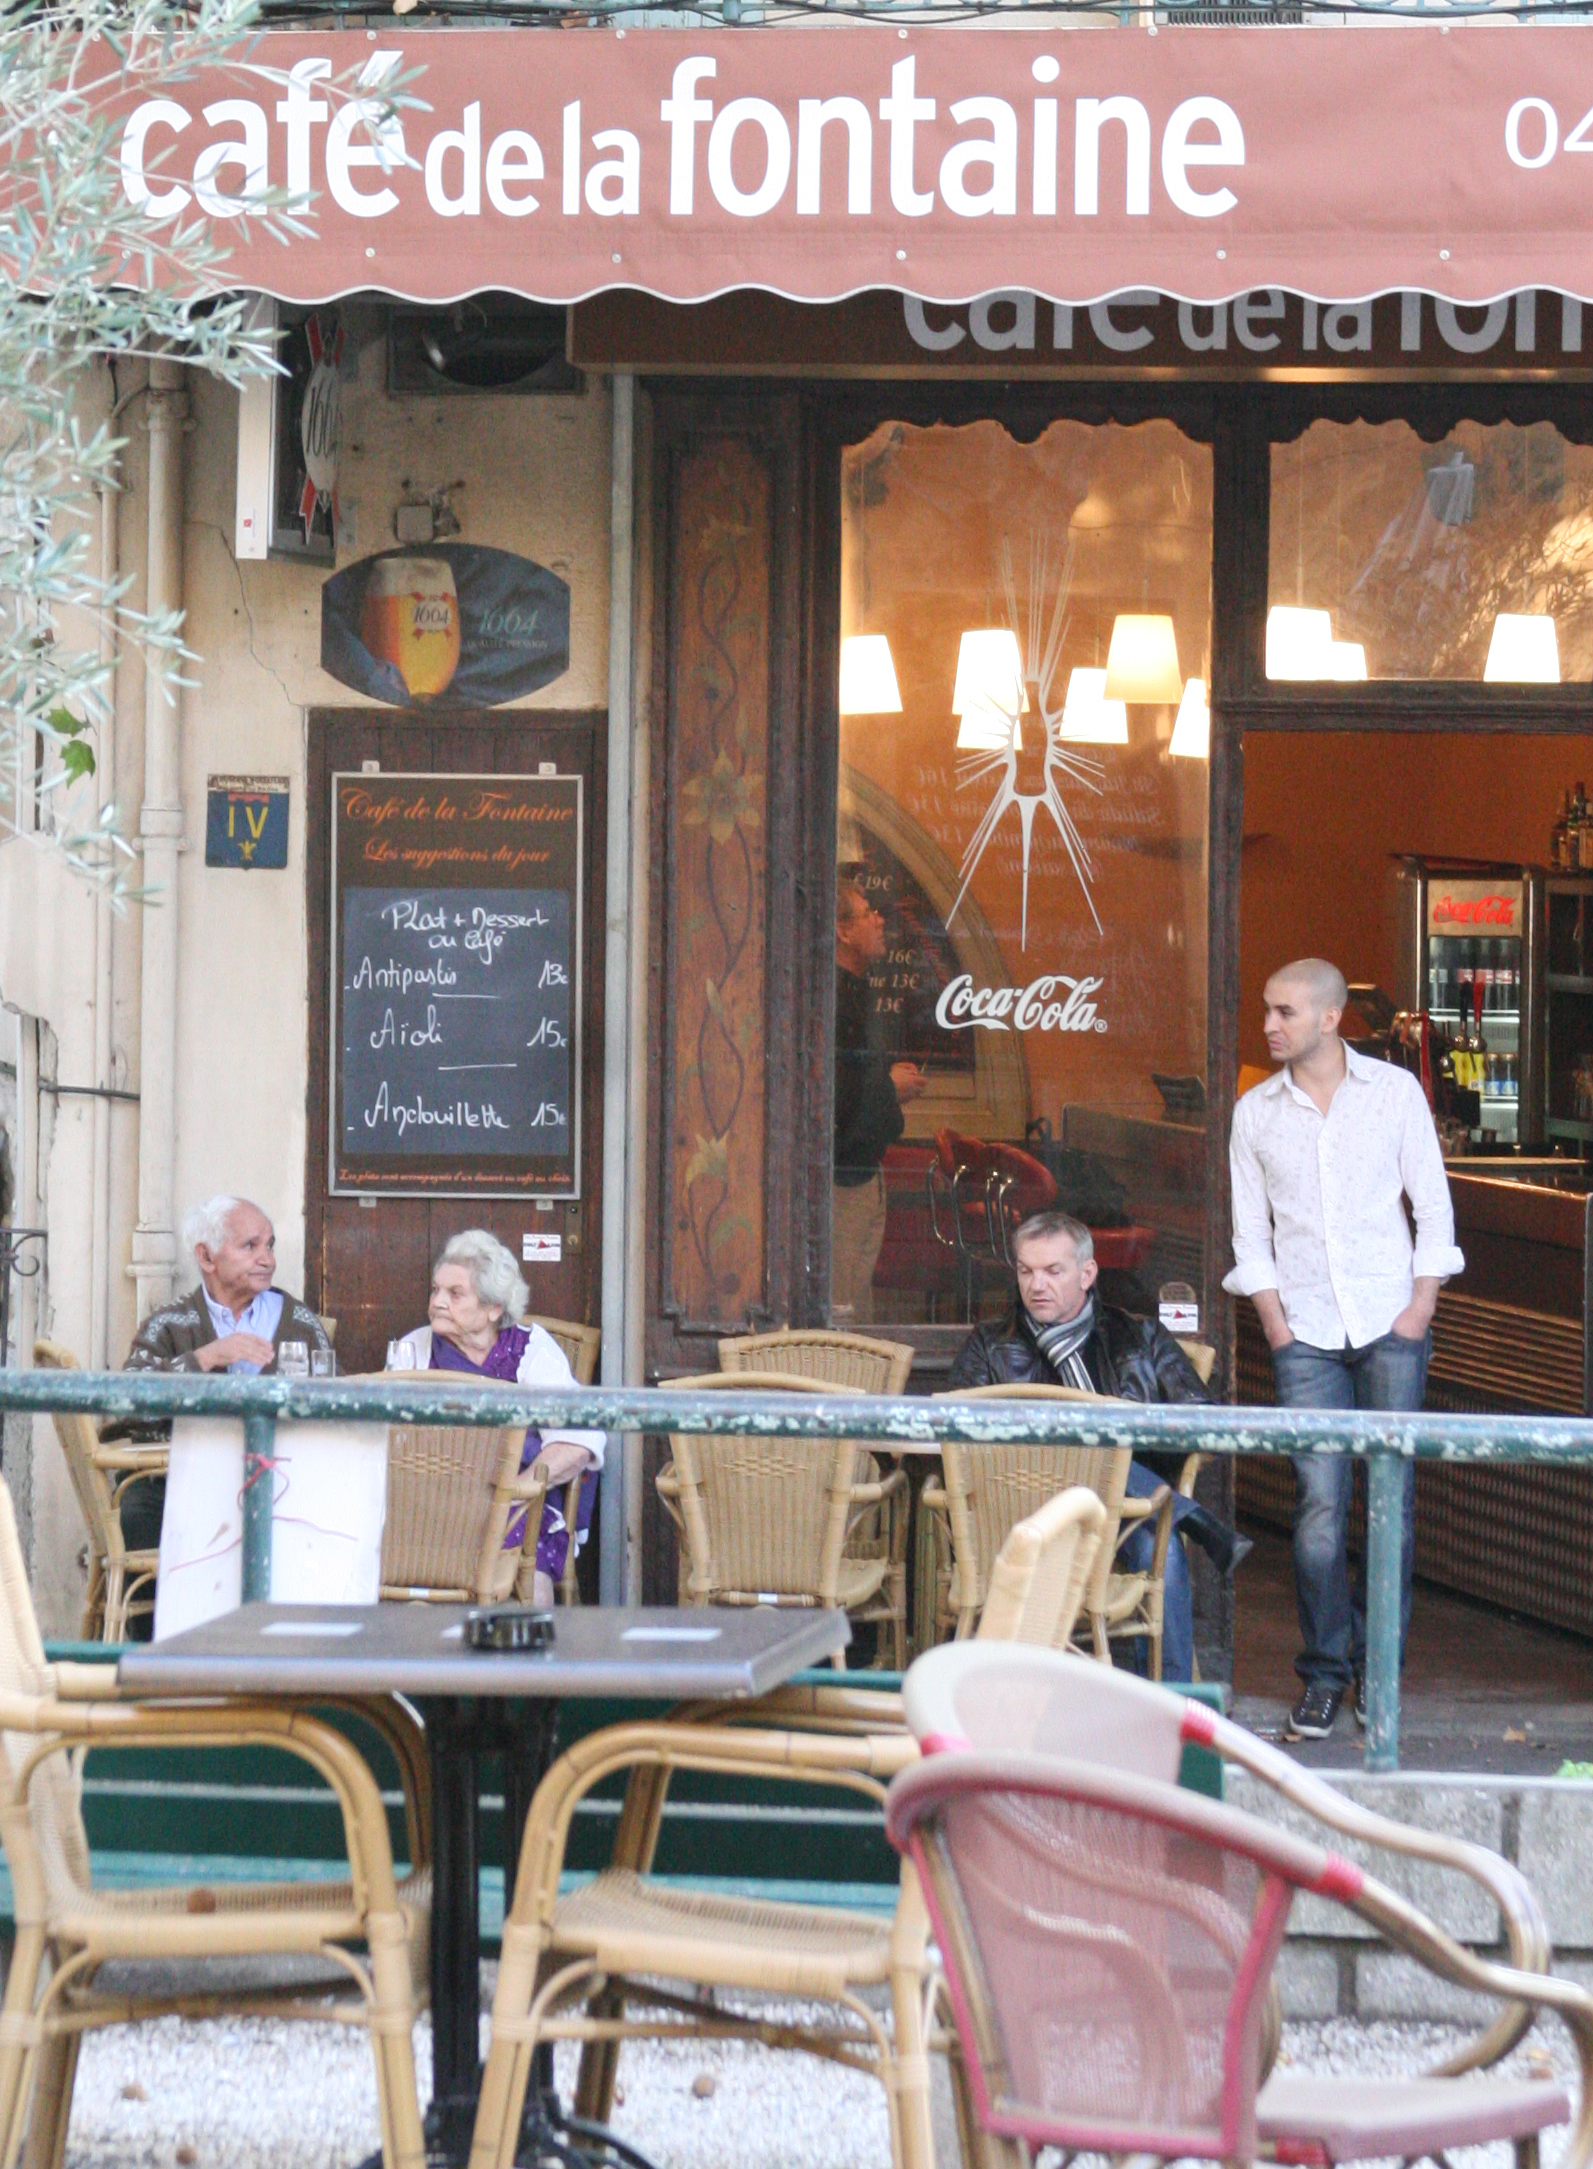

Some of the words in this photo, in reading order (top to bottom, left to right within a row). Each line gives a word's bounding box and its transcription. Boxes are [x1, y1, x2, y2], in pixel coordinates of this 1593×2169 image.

[120, 50, 403, 218] café
[425, 101, 544, 217] de
[563, 101, 640, 216] la
[660, 55, 1245, 217] fontaine
[340, 787, 404, 828] Café
[404, 796, 431, 820] de
[434, 797, 456, 820] la
[463, 791, 573, 820] Fontaine
[363, 837, 399, 863] Les
[401, 846, 489, 871] suggestions
[492, 844, 513, 862] du
[510, 848, 551, 873] jour
[472, 906, 550, 929] Dessert
[1433, 895, 1516, 925] Coca-Cola
[428, 933, 458, 949] ou
[464, 930, 507, 965] Café
[868, 973, 887, 989] ne
[935, 974, 1104, 1032] Coca-Cola
[369, 1004, 444, 1050] Aïoli
